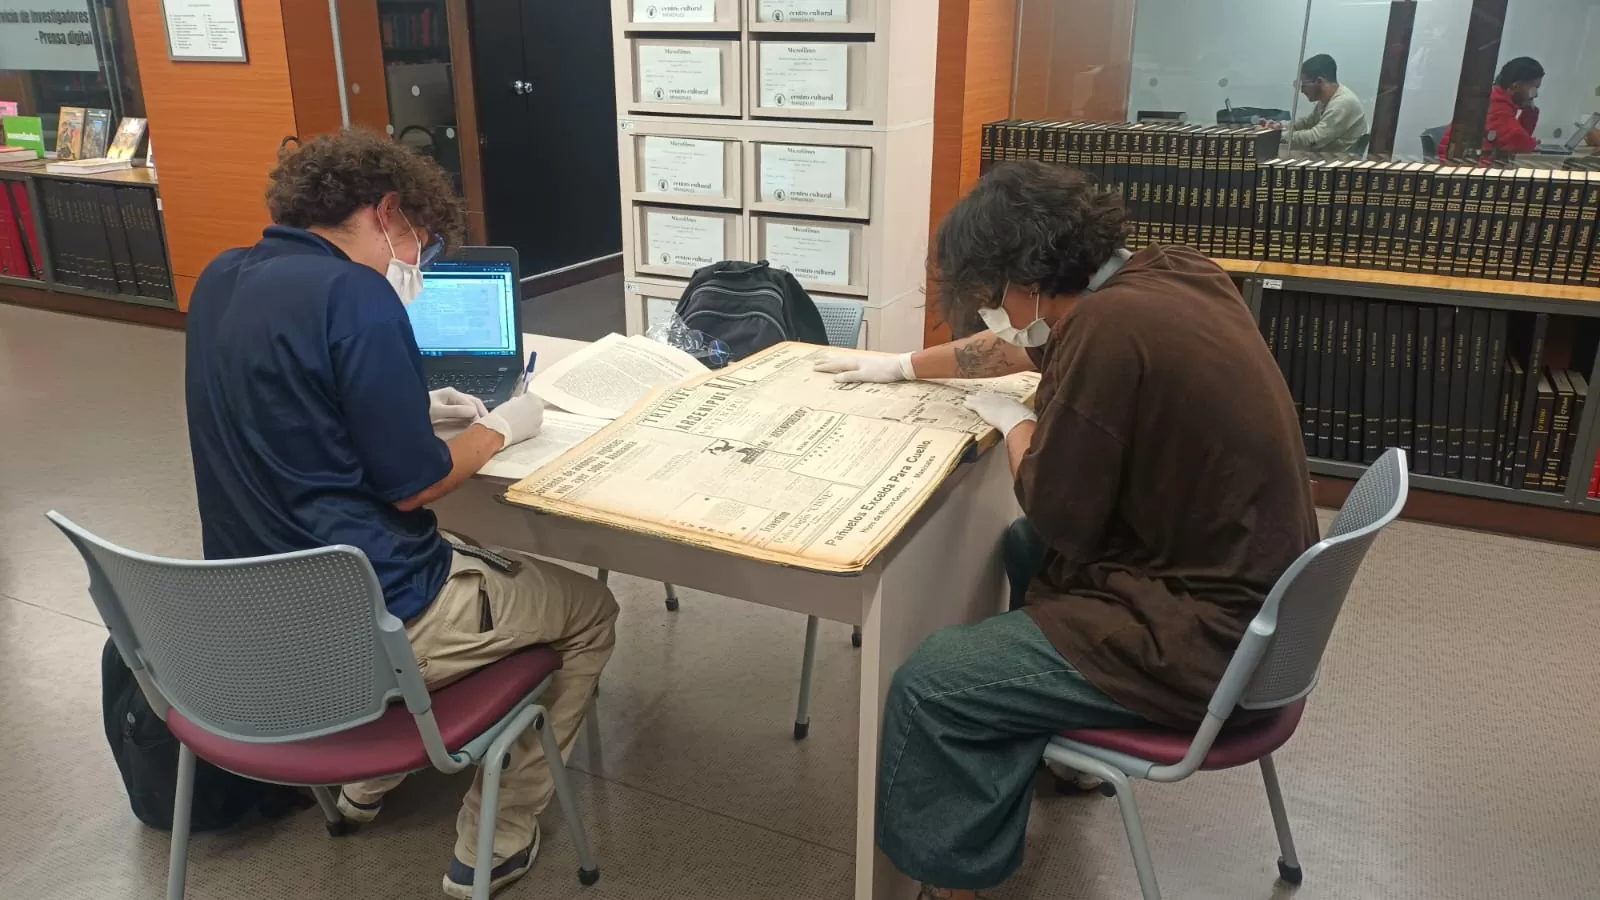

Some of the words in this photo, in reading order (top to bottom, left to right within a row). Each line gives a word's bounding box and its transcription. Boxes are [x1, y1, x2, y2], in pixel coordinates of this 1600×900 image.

[30, 10, 89, 25] Investigadores
[38, 30, 67, 44] Prensa
[67, 30, 93, 46] digital
[824, 512, 867, 546] Pañuelos
[861, 483, 895, 511] Excelda
[889, 465, 912, 483] Para
